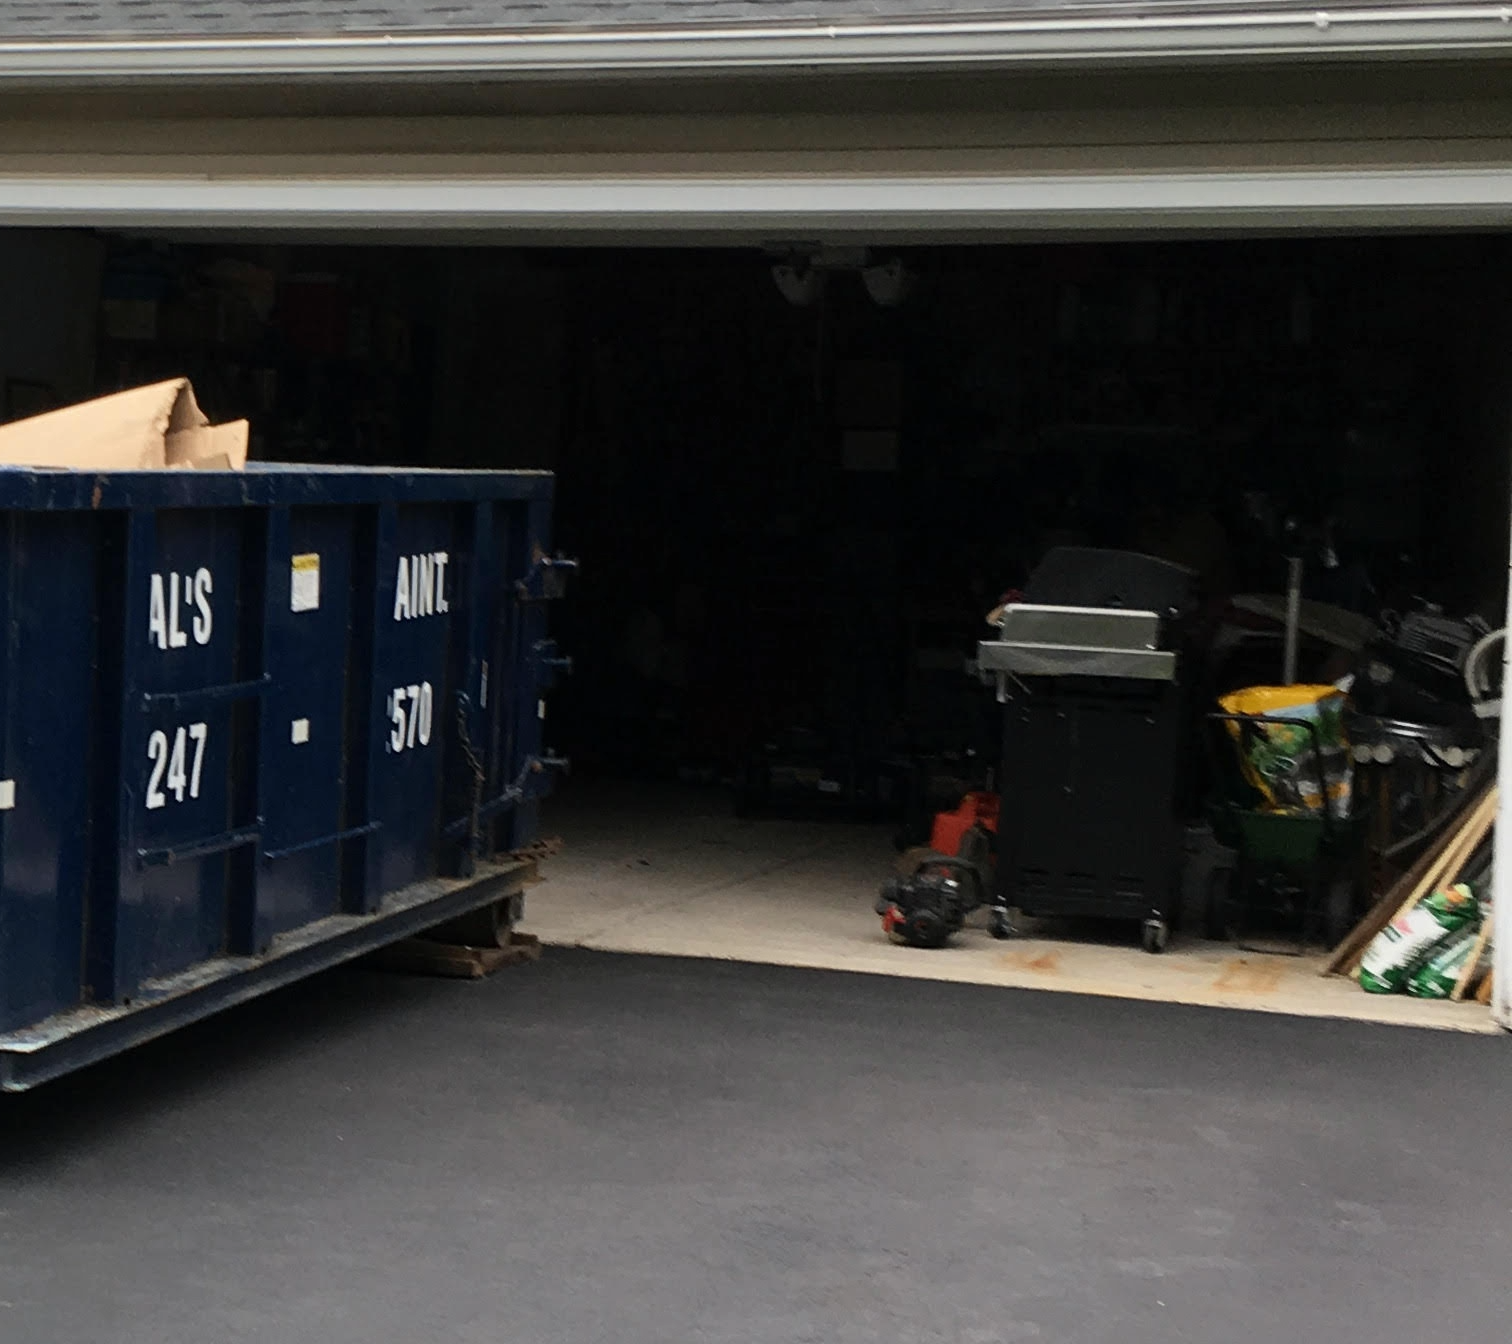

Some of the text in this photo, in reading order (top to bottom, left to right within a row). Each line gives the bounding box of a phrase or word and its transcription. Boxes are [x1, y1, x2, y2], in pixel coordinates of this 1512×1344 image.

[149, 567, 213, 650] AL'S
[145, 680, 433, 810] 247 570
